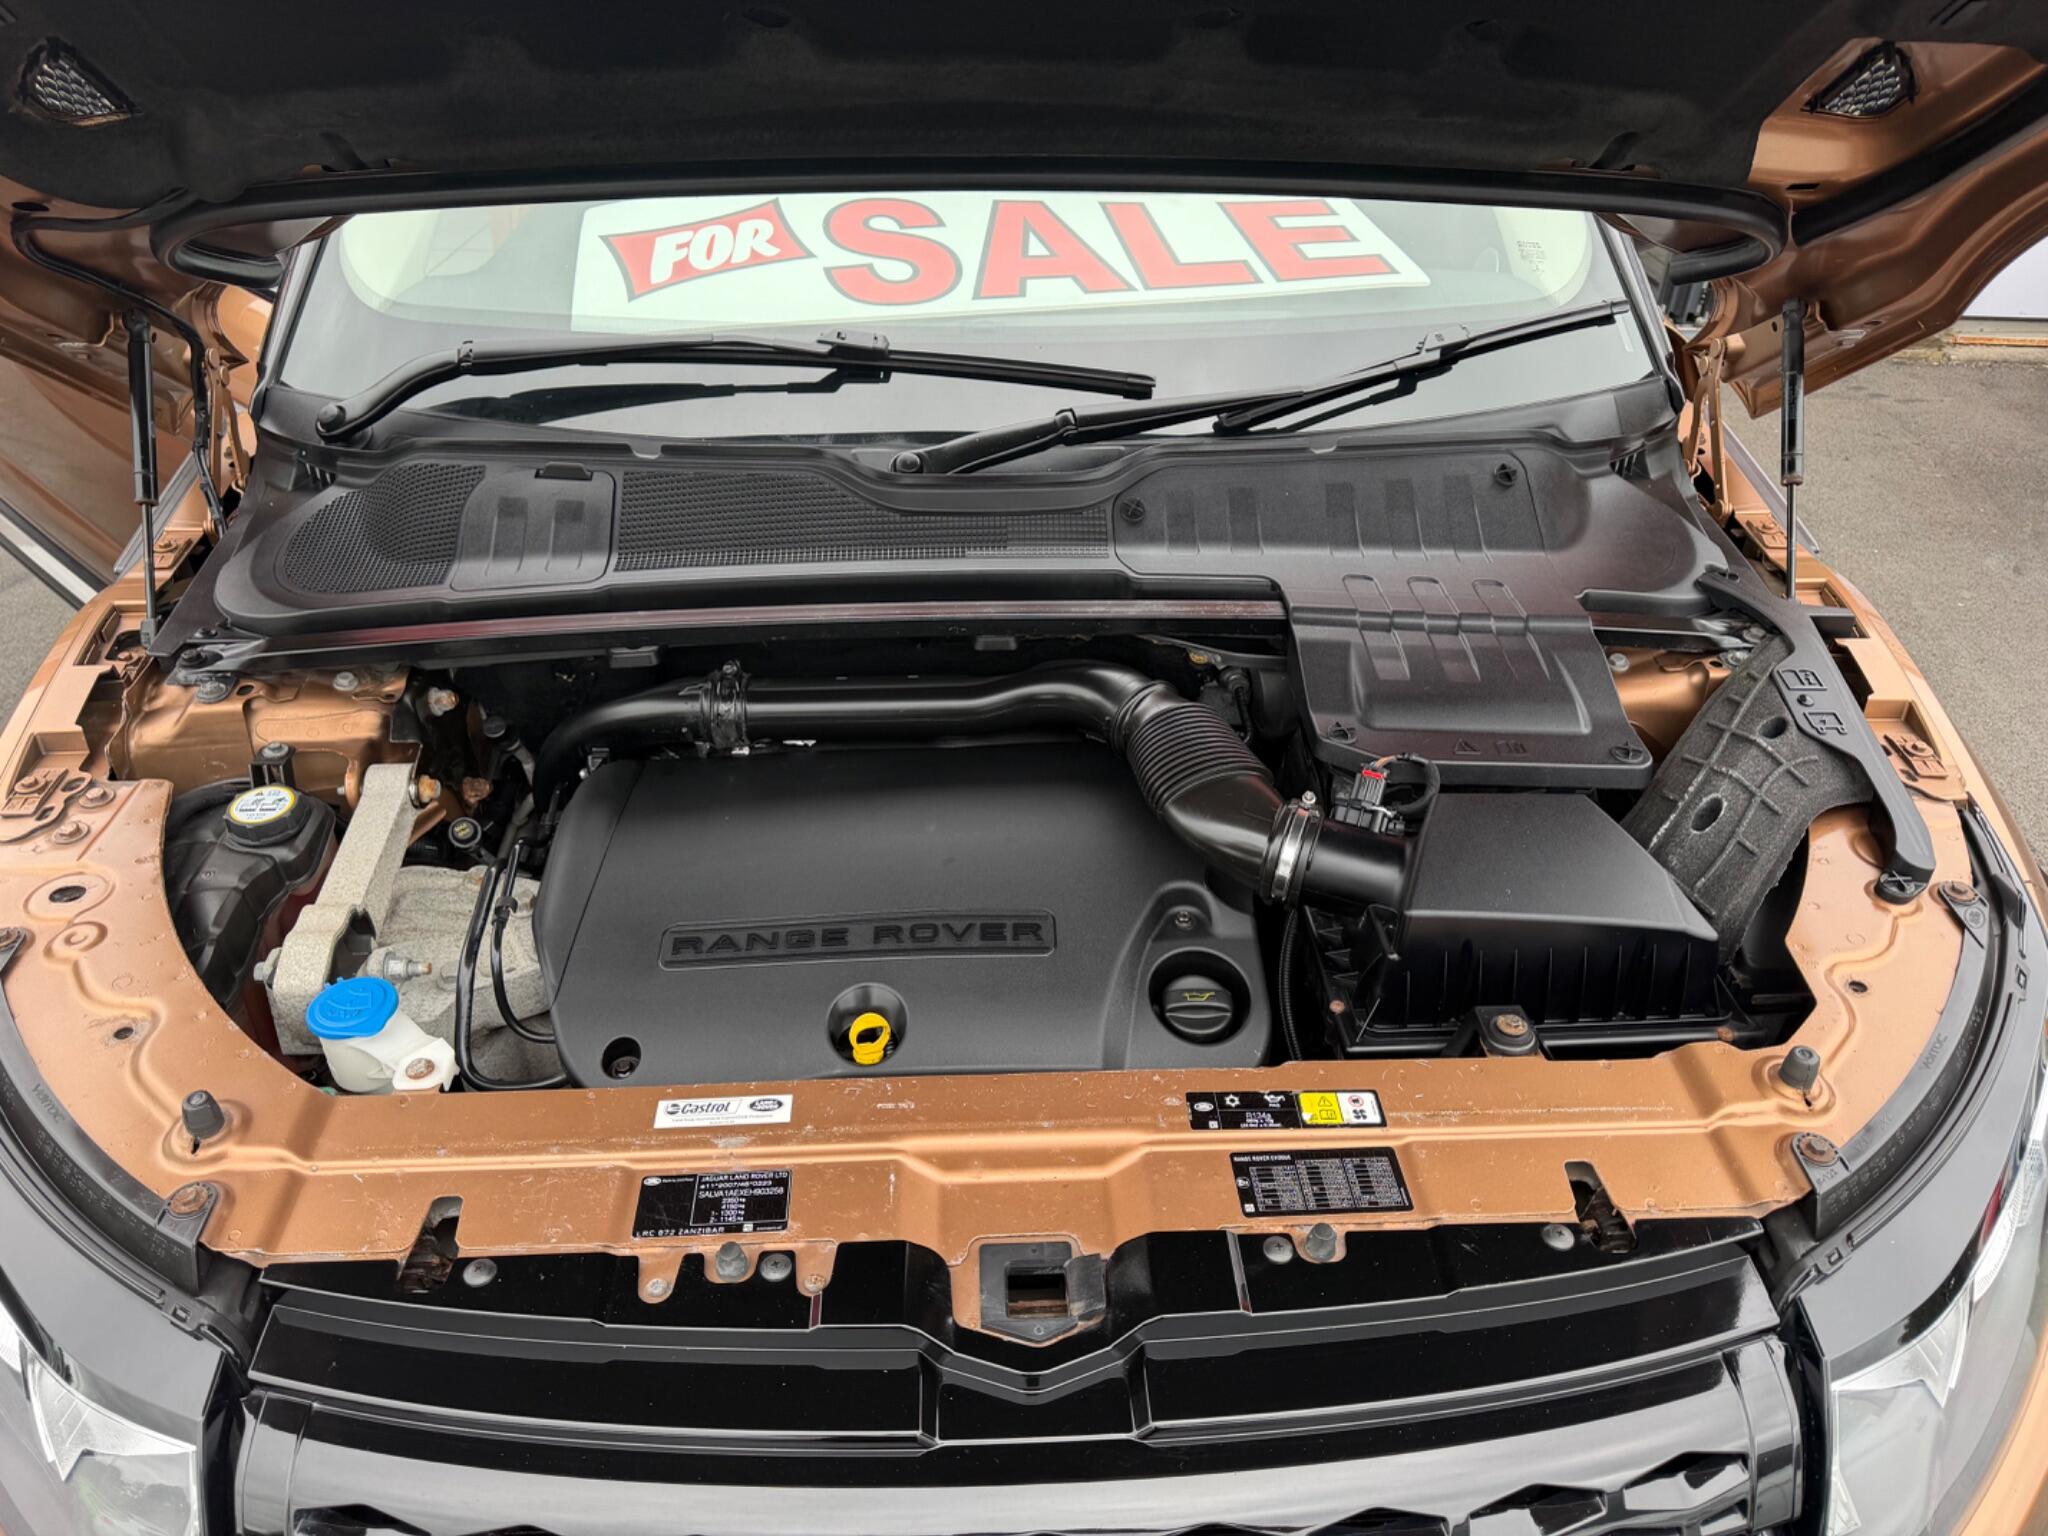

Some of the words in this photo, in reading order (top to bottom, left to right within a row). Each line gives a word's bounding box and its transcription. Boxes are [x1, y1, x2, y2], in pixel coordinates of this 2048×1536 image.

[650, 218, 780, 285] FOR
[823, 197, 1401, 306] SALE
[671, 926, 850, 956] RANGE
[873, 922, 1044, 945] ROVER
[681, 1101, 731, 1114] Castrol
